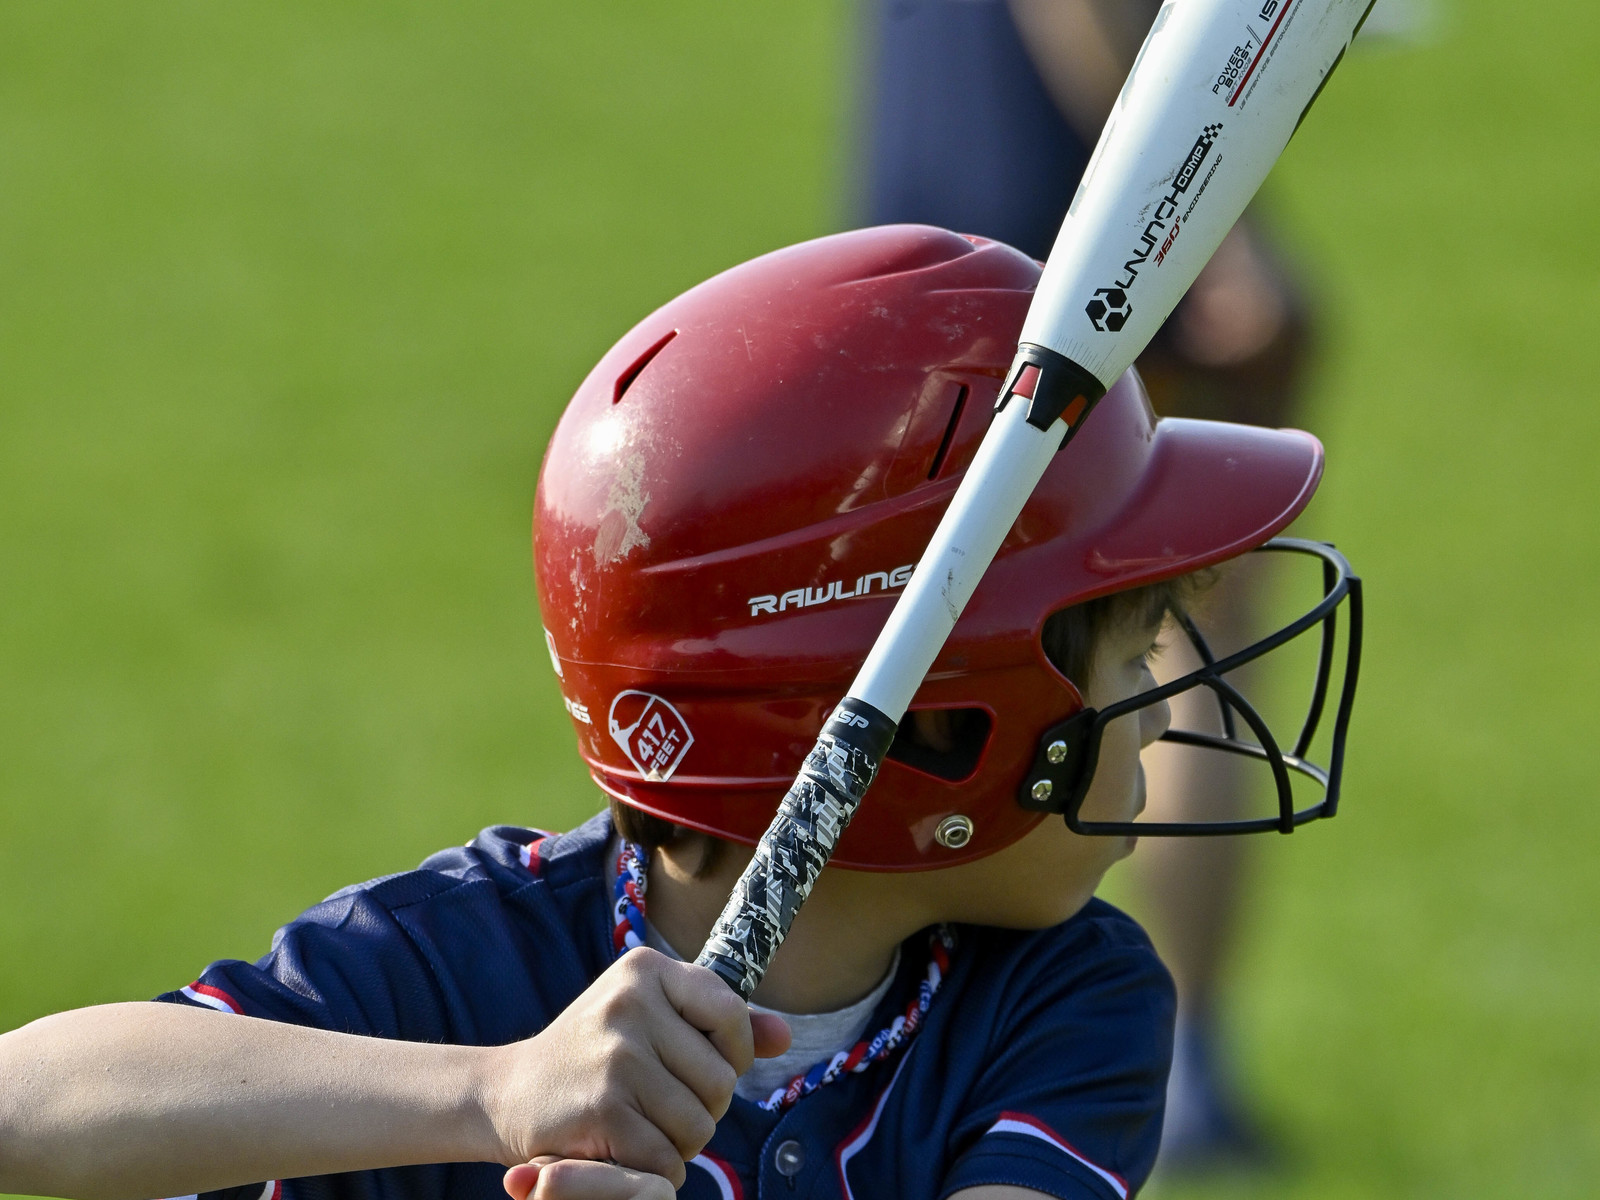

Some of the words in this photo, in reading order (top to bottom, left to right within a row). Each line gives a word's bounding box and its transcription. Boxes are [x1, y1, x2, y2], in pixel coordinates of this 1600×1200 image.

[1212, 45, 1243, 95] POWER
[1224, 40, 1253, 88] BOOST
[1181, 153, 1223, 224] ENGINEERING
[1114, 187, 1182, 289] LAUNCH
[1176, 144, 1204, 188] COMP
[747, 563, 919, 617] RAWLING
[637, 711, 667, 762] 417
[650, 728, 681, 771] FEET
